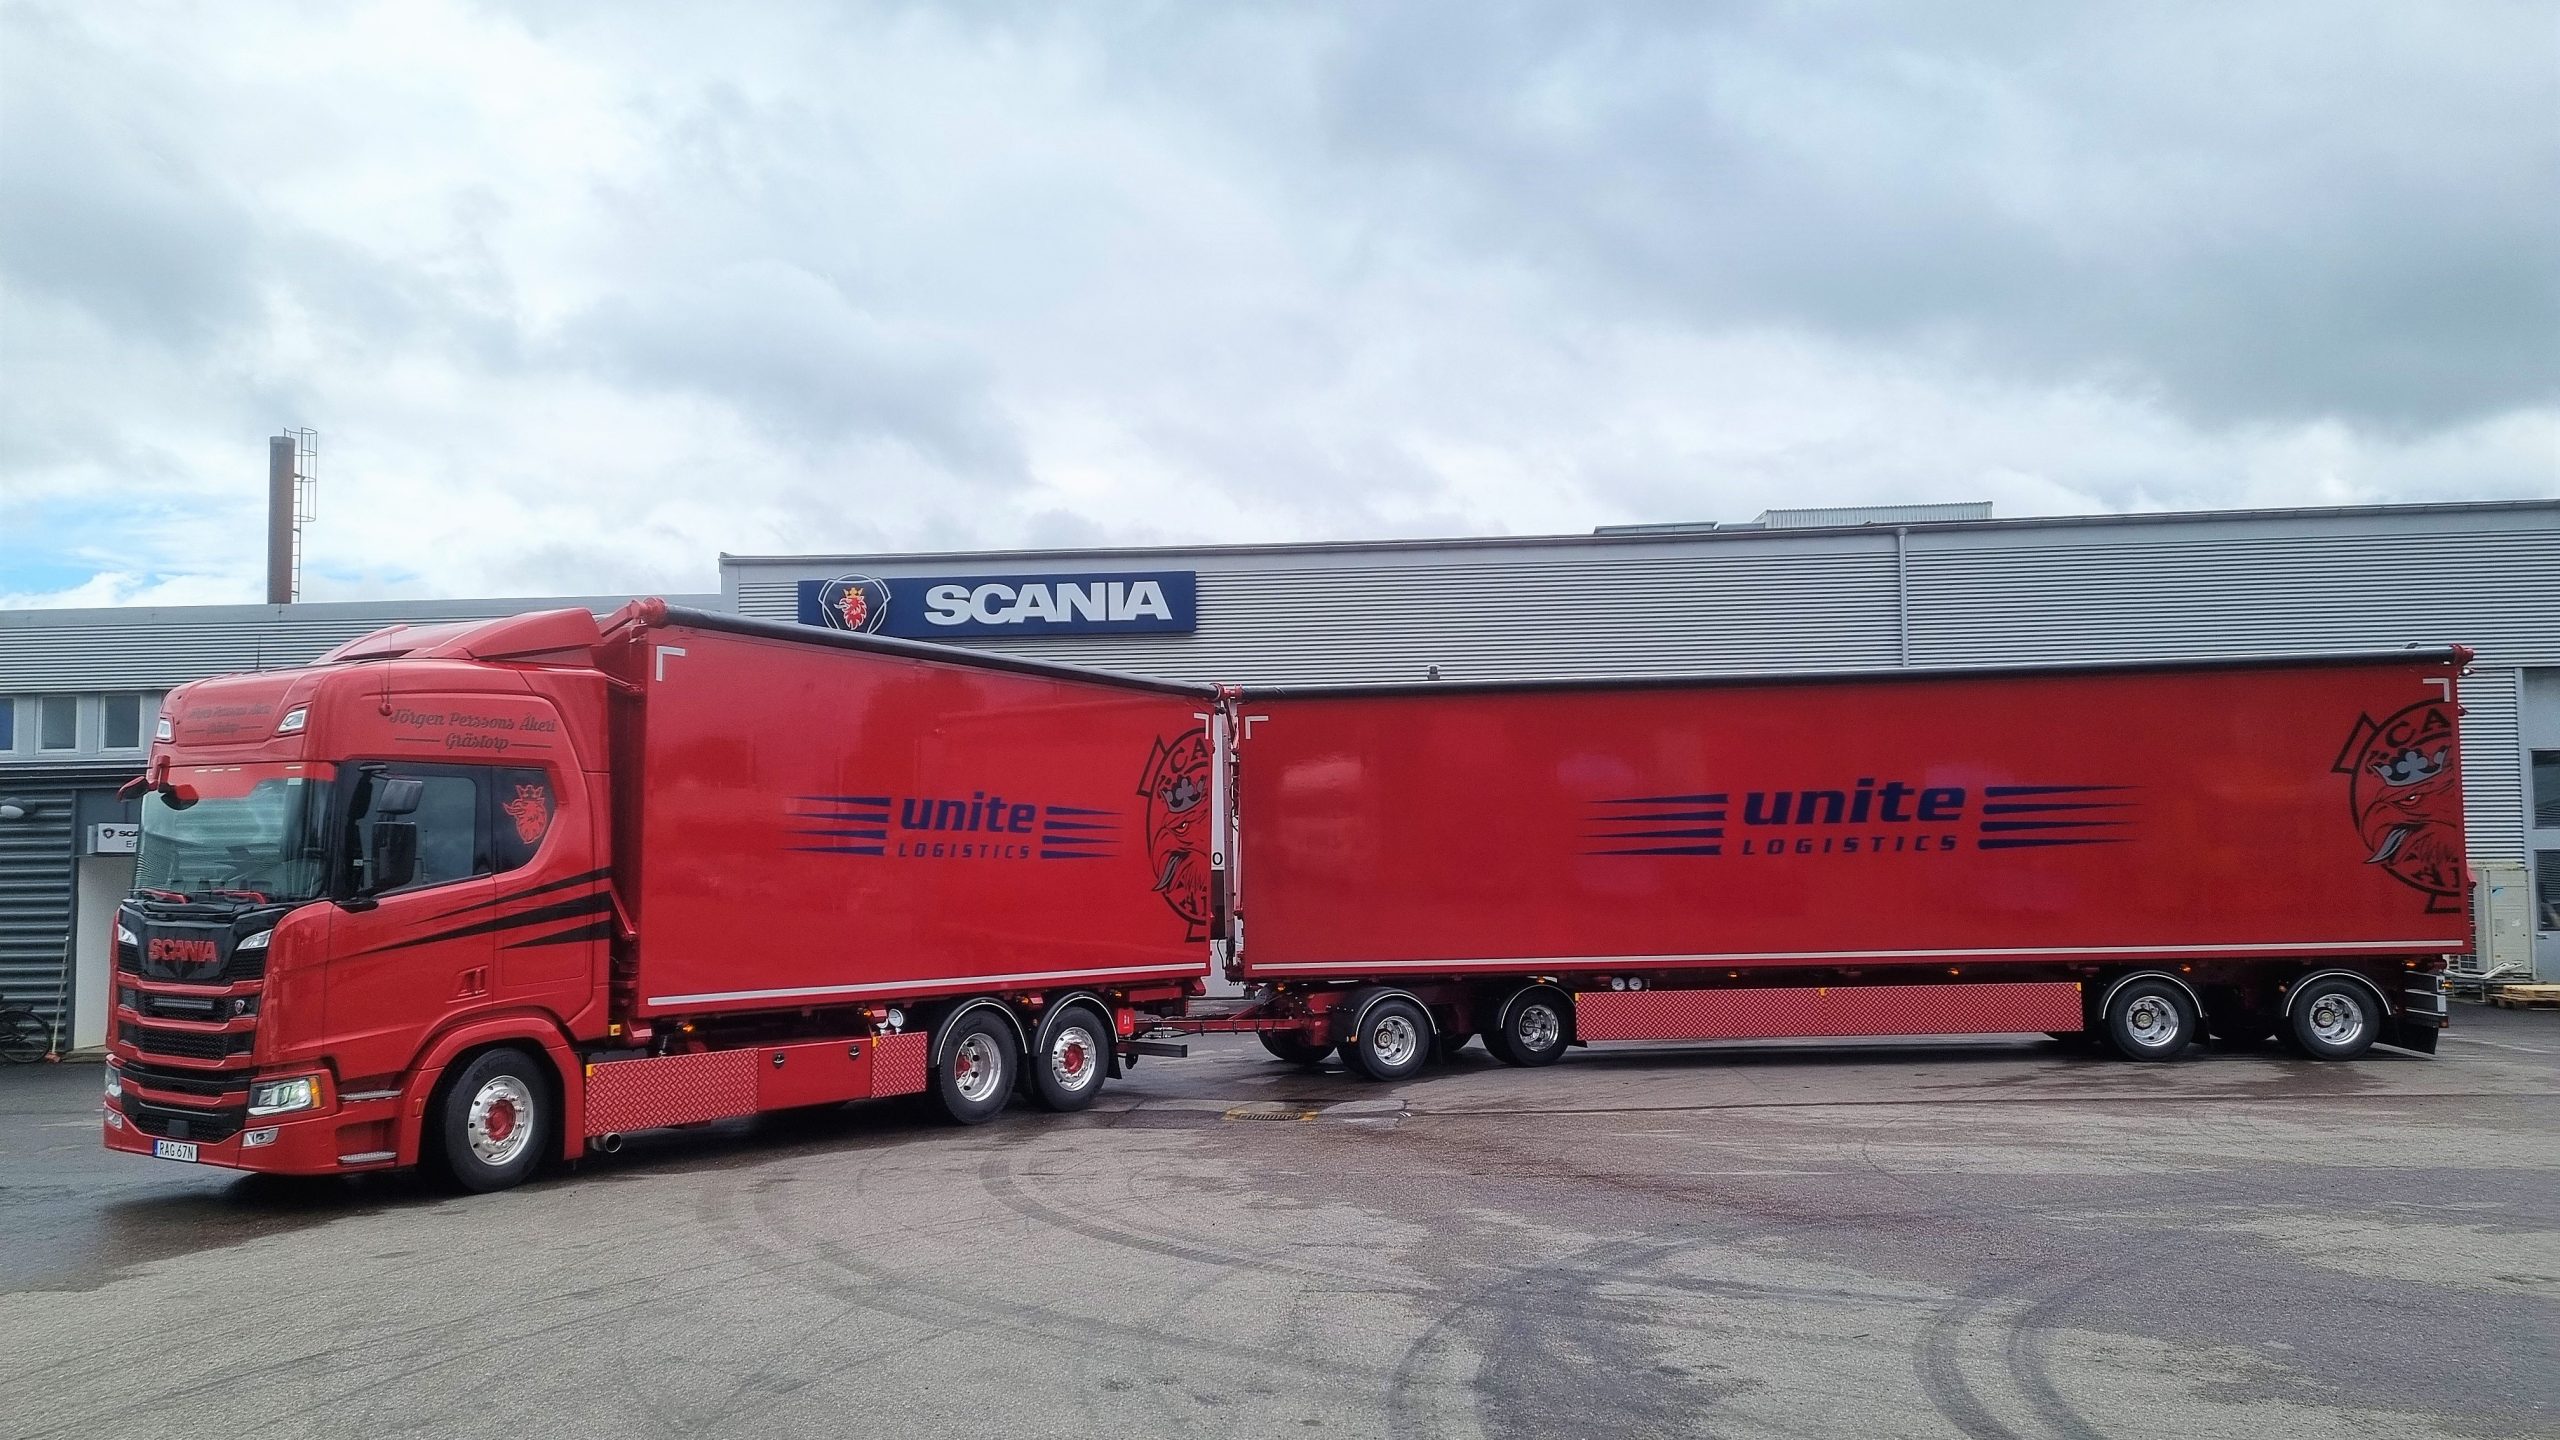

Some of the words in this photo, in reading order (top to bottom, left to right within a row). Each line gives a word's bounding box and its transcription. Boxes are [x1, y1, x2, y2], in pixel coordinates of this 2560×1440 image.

[924, 580, 1173, 626] SCANIA
[449, 712, 514, 730] Perssons
[445, 732, 509, 753] Grästorp
[1743, 777, 1966, 825] unite
[901, 791, 1036, 833] unite
[898, 843, 1029, 859] LOGISTICS
[1742, 835, 1957, 855] LOGISTICS
[148, 938, 217, 962] SCANIA
[160, 1142, 175, 1157] RAG
[176, 1145, 194, 1159] 67N
